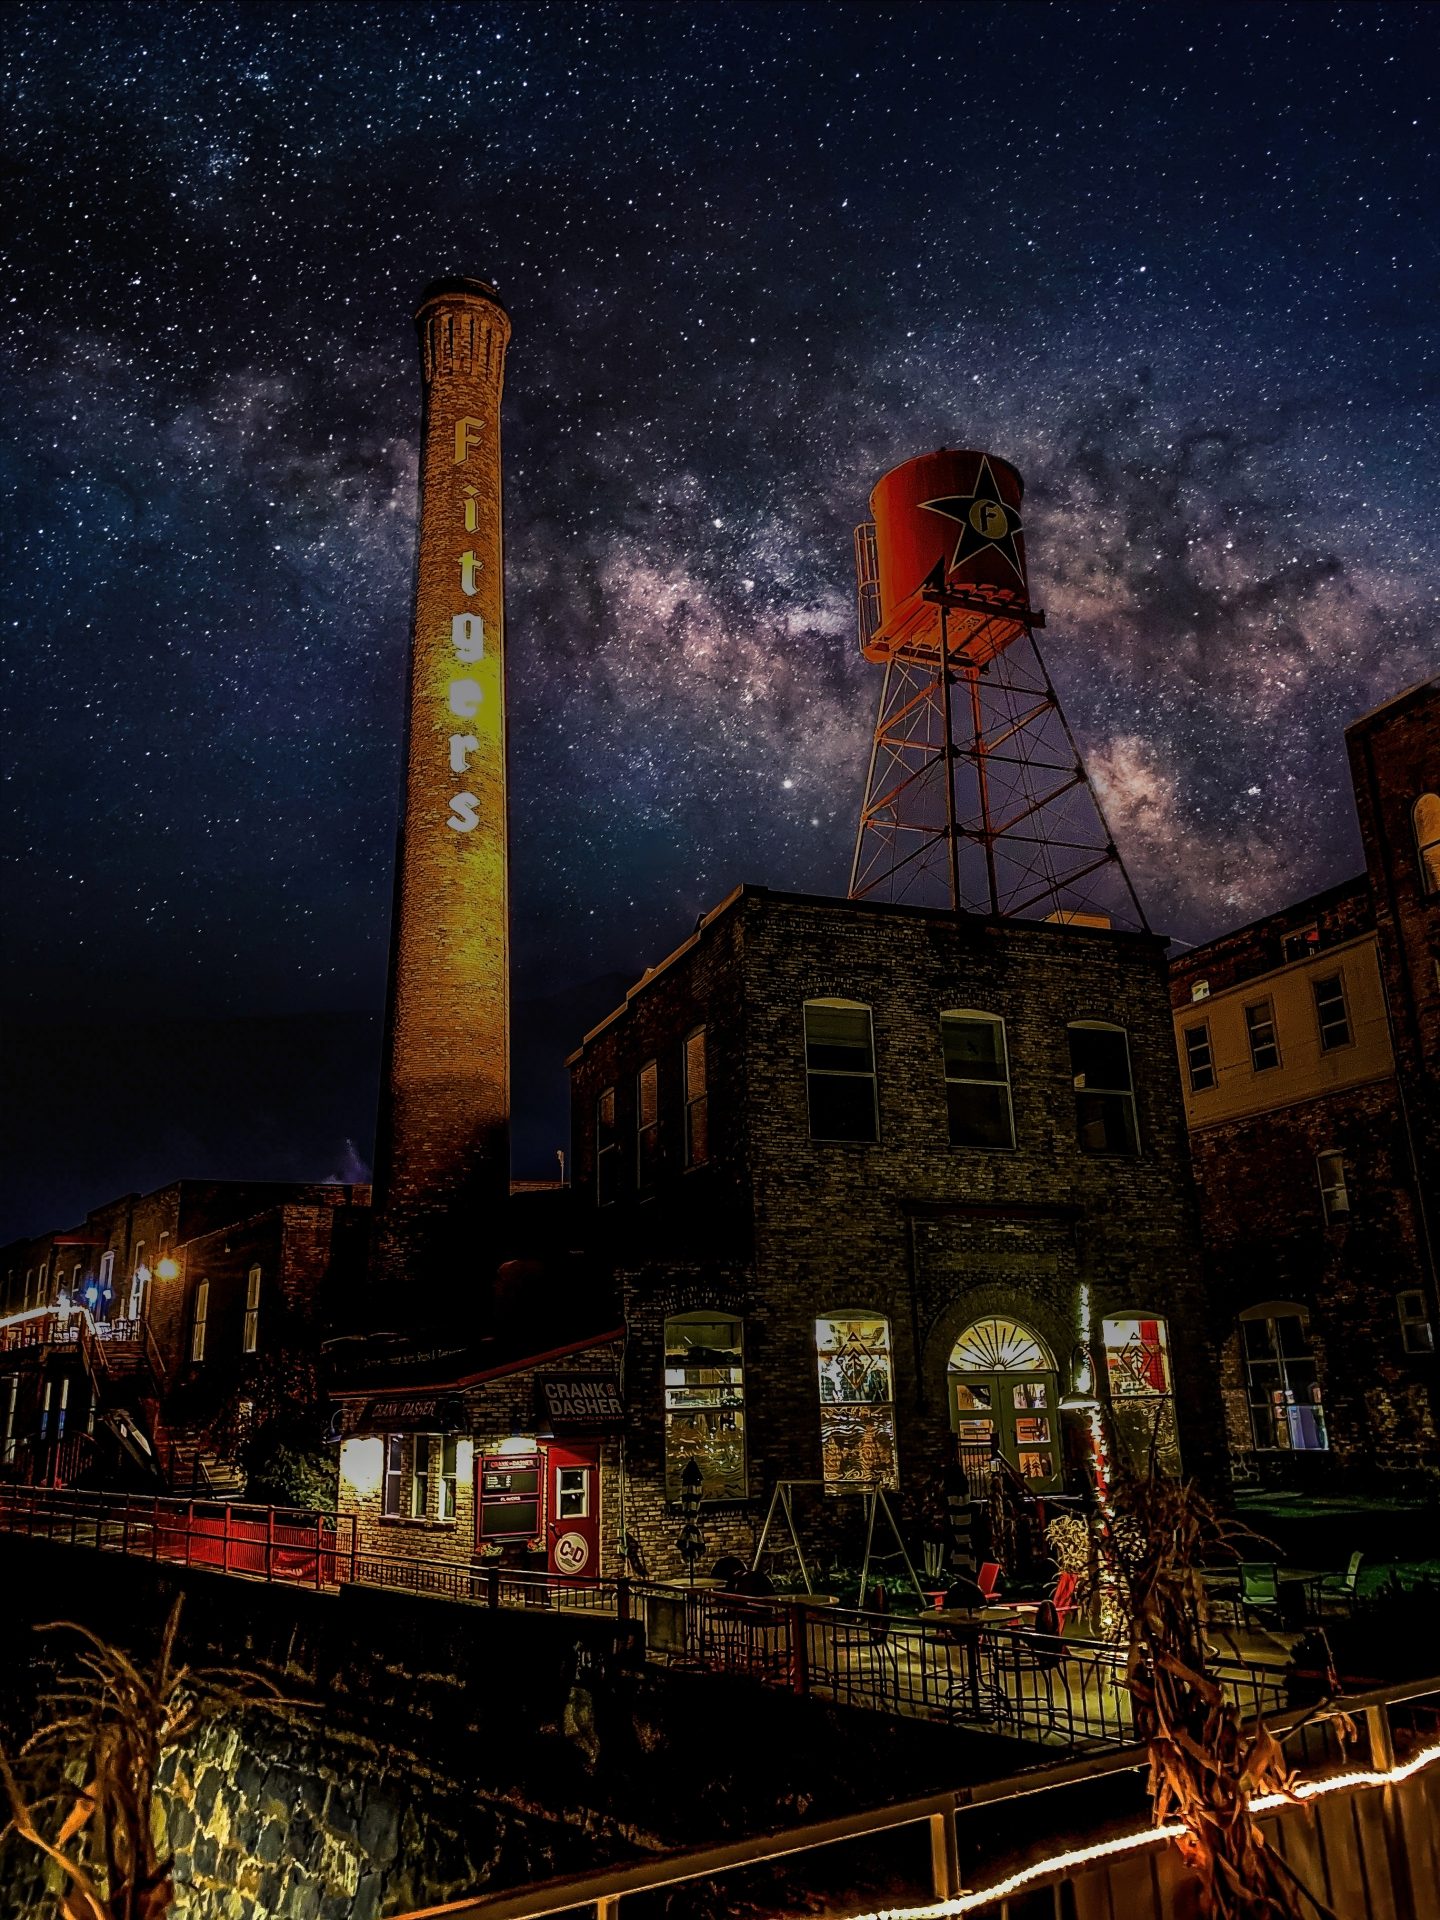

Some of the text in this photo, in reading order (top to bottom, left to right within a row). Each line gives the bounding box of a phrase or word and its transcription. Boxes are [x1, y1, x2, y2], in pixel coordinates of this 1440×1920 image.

[979, 502, 998, 533] F
[544, 1382, 608, 1399] CRANK
[400, 1400, 437, 1417] DASHER
[549, 1398, 624, 1415] DASHER
